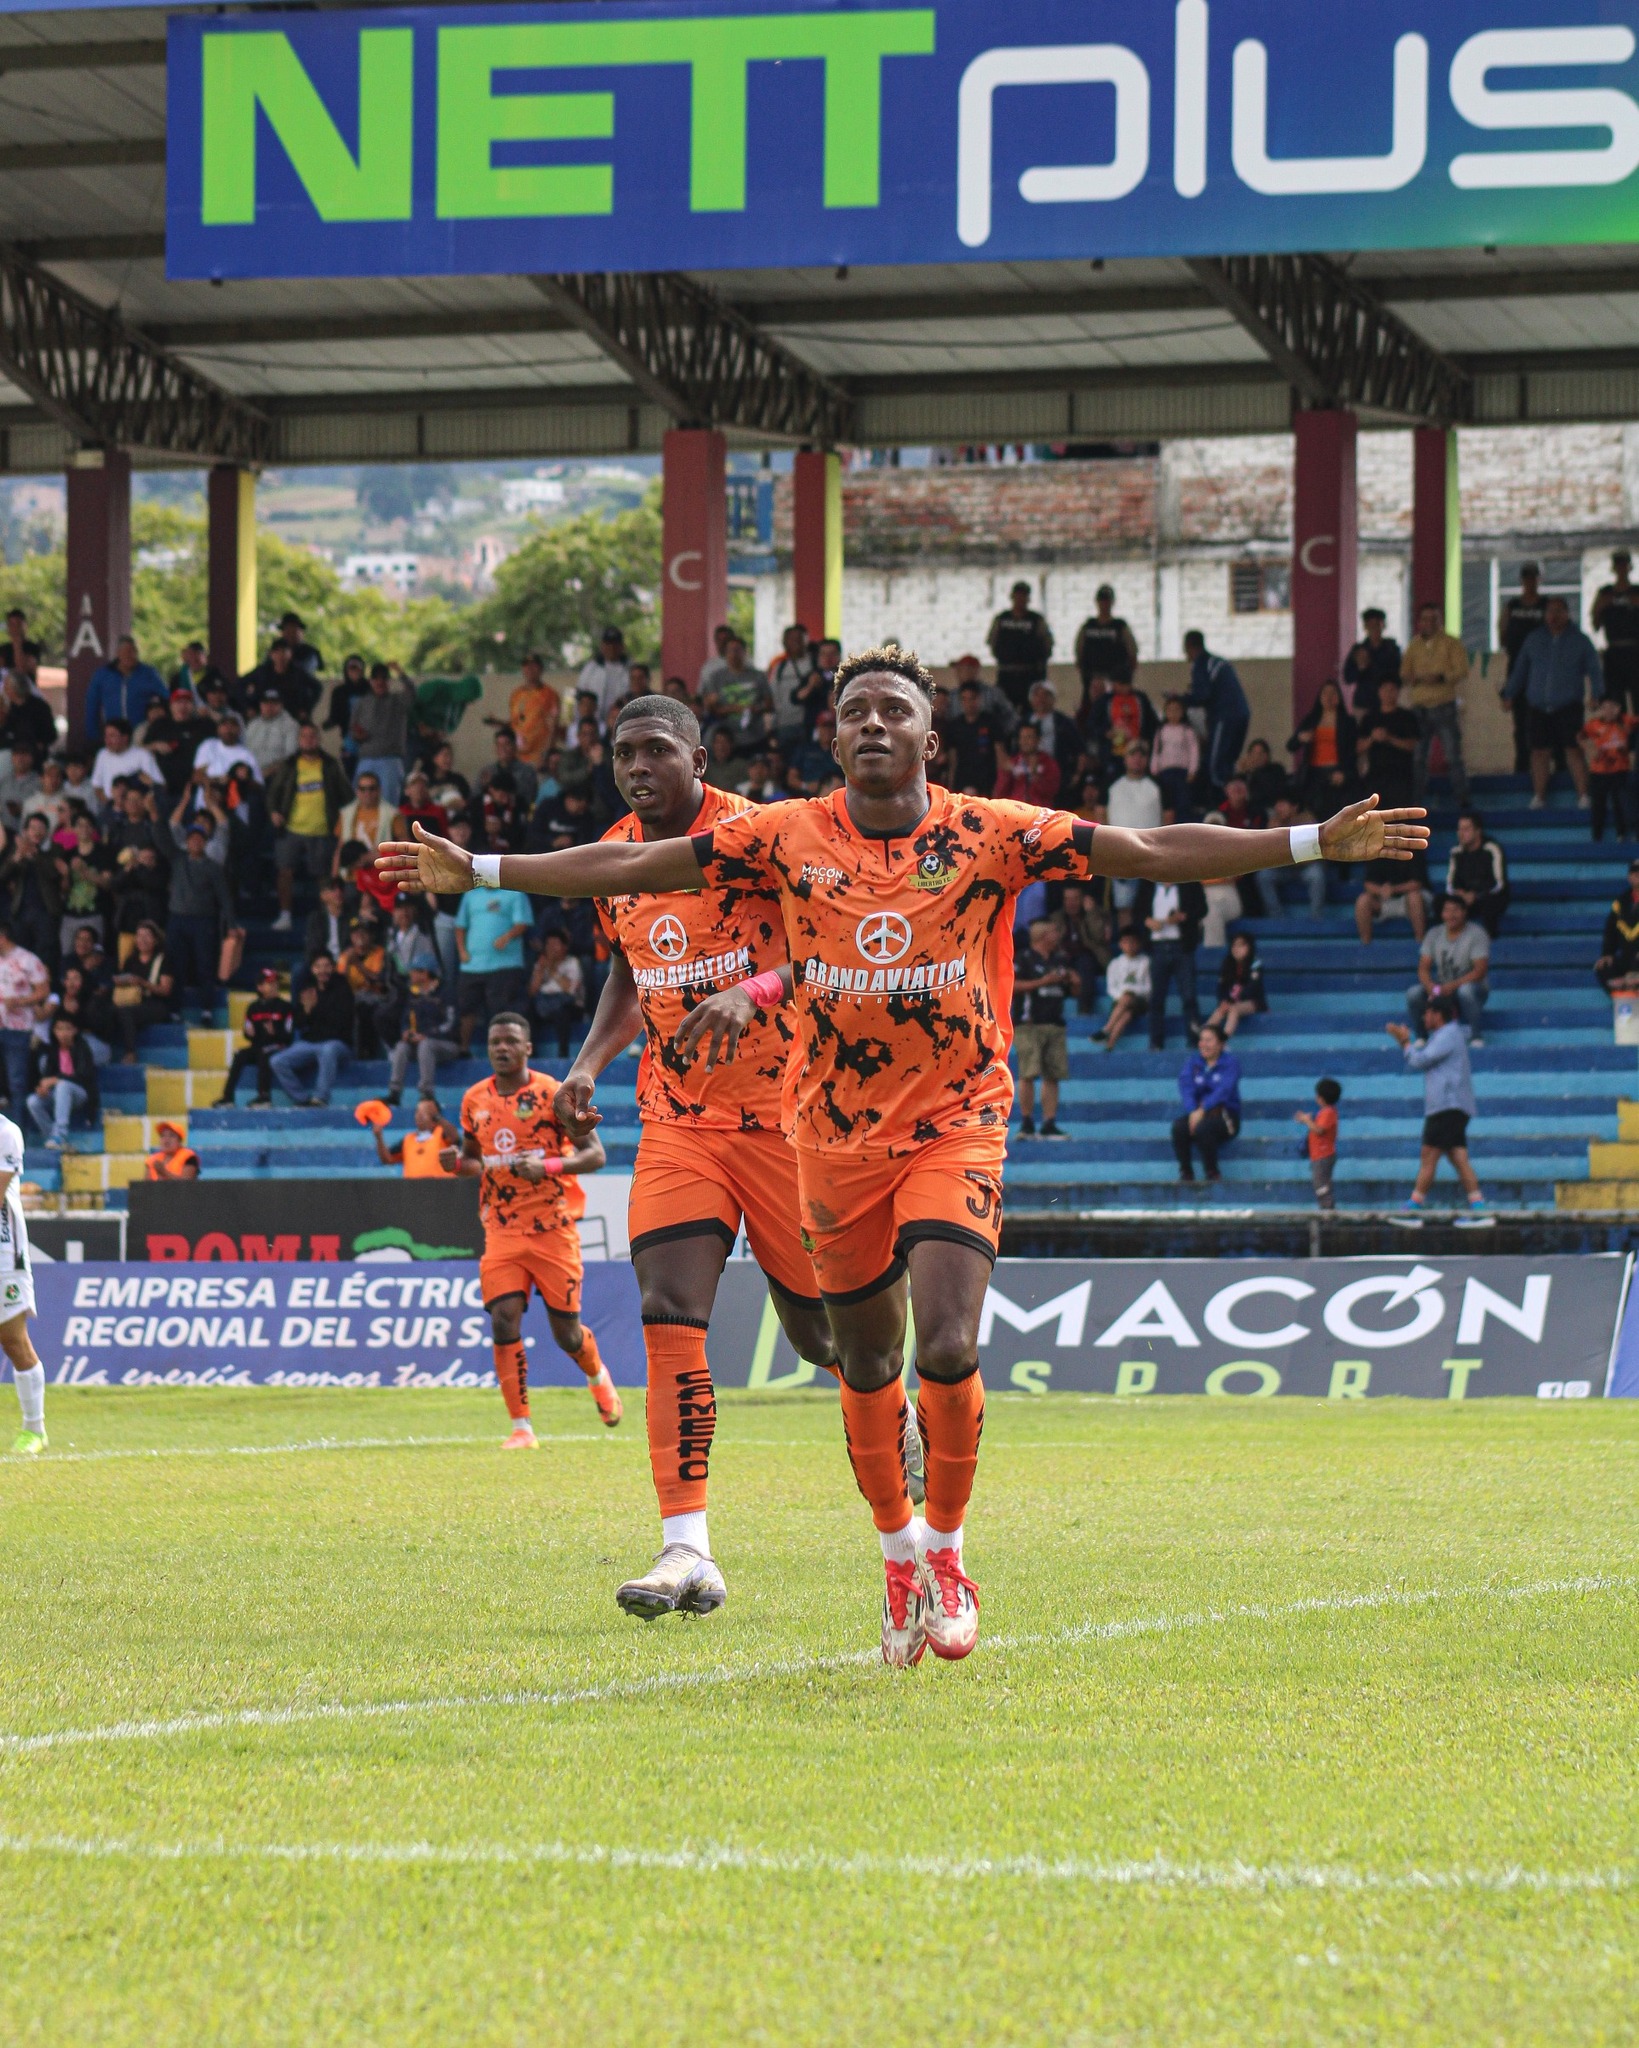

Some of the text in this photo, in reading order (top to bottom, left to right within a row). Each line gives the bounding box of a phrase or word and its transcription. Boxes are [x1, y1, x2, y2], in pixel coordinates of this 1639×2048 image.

[669, 550, 703, 591] C
[1300, 535, 1335, 576] C
[71, 620, 103, 658] A
[877, 996, 893, 1004] DE
[73, 1271, 484, 1308] EMPRESA ELÉCTRIC
[62, 1316, 270, 1347] REGIONAL
[279, 1316, 358, 1347] DEL
[366, 1316, 451, 1347] SUR
[1010, 1359, 1483, 1400] SPORT
